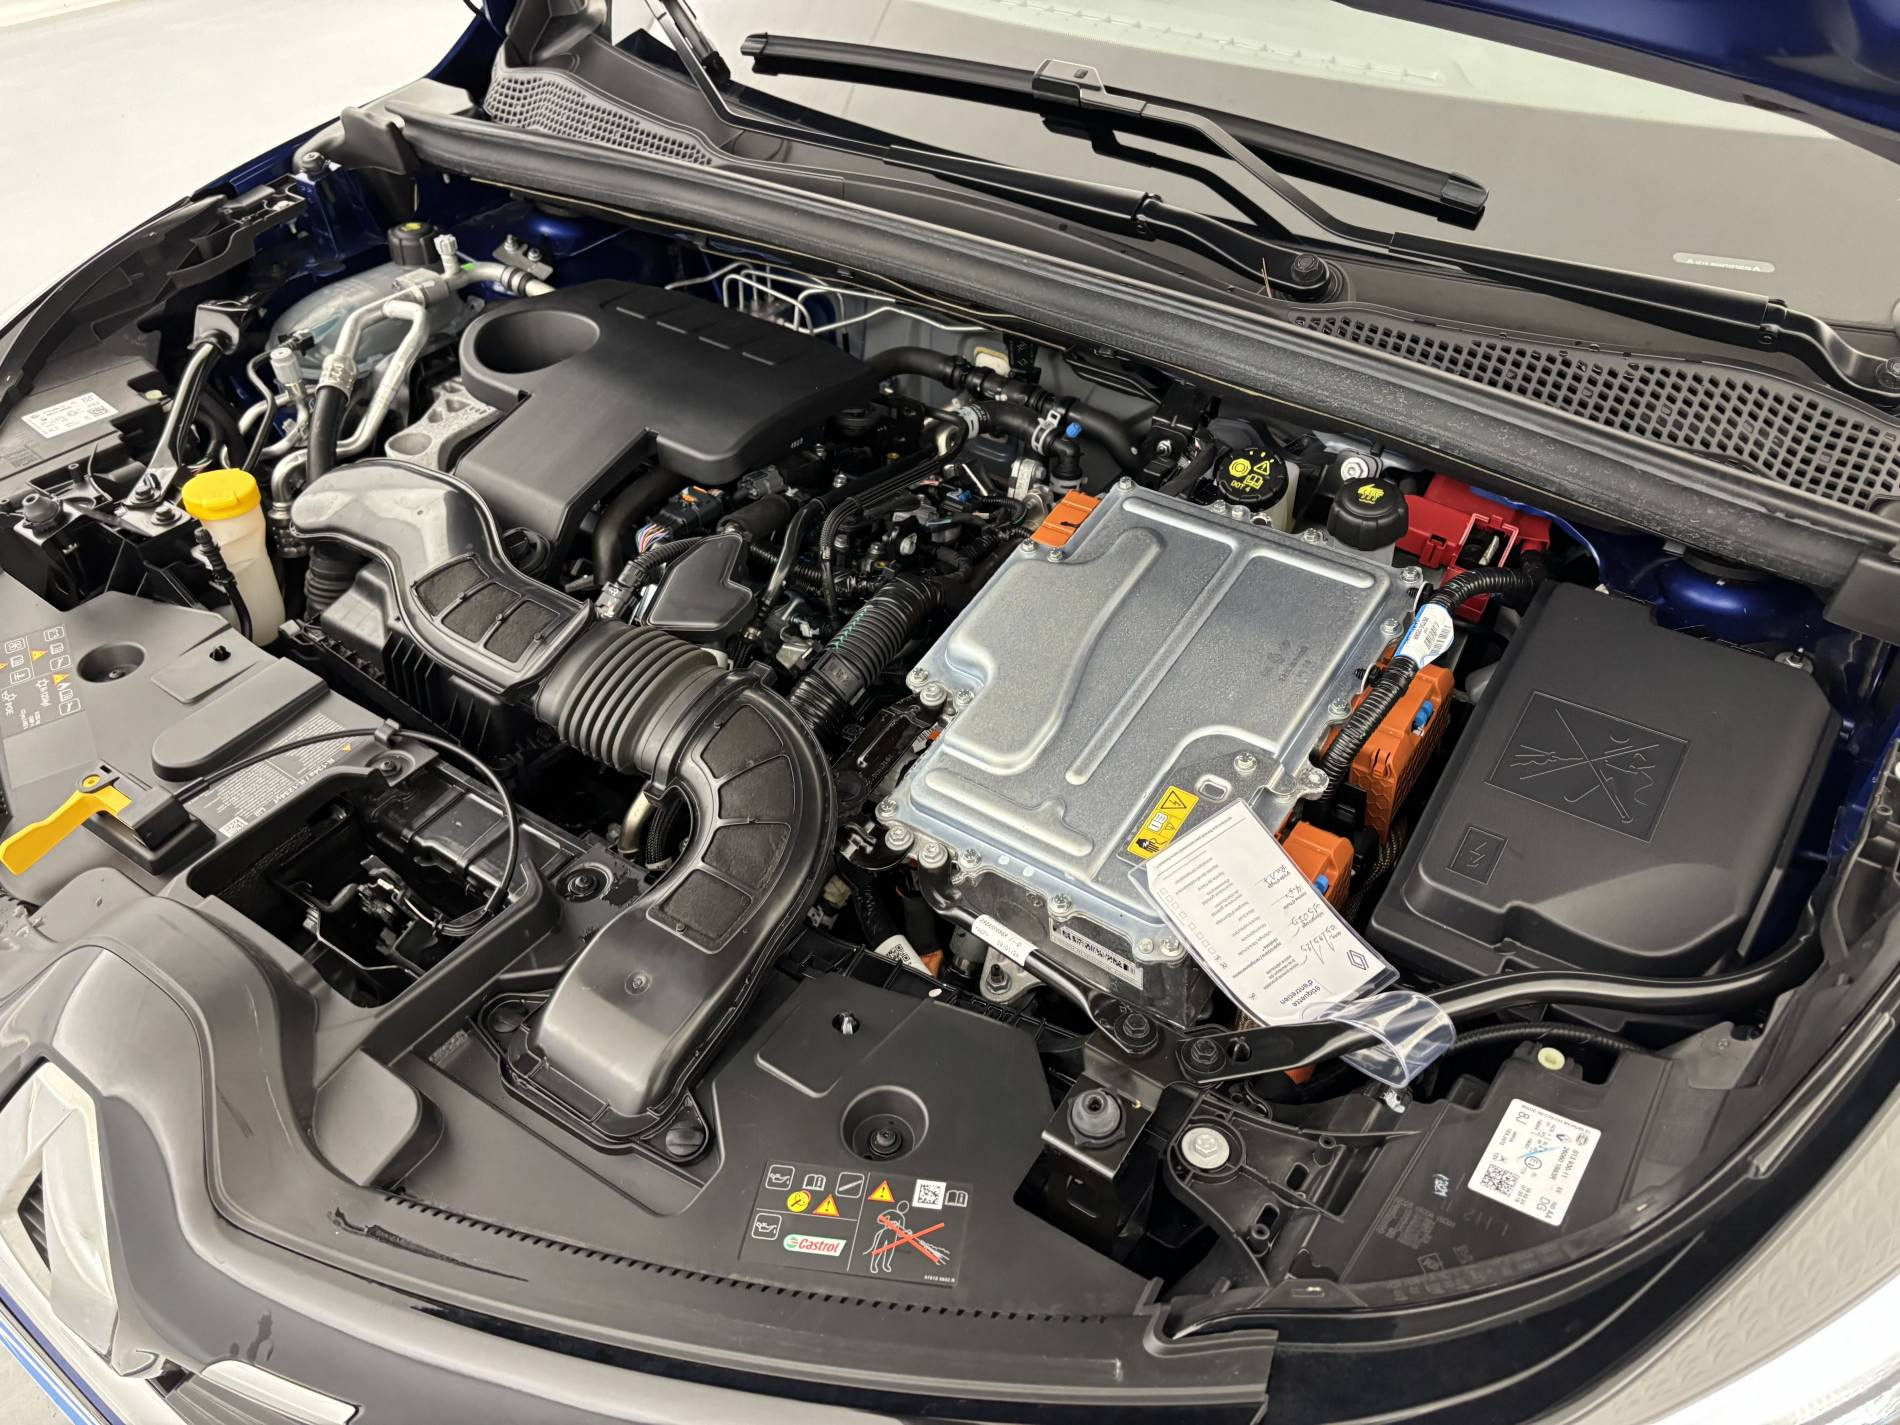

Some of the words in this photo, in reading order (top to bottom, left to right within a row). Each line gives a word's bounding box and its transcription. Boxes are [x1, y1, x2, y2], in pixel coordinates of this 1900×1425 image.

[1230, 479, 1245, 489] DOT
[1280, 979, 1314, 1005] d'entretien
[1290, 984, 1321, 1007] étiquette
[1536, 1196, 1550, 1212] DG
[798, 1237, 839, 1253] Castrol
